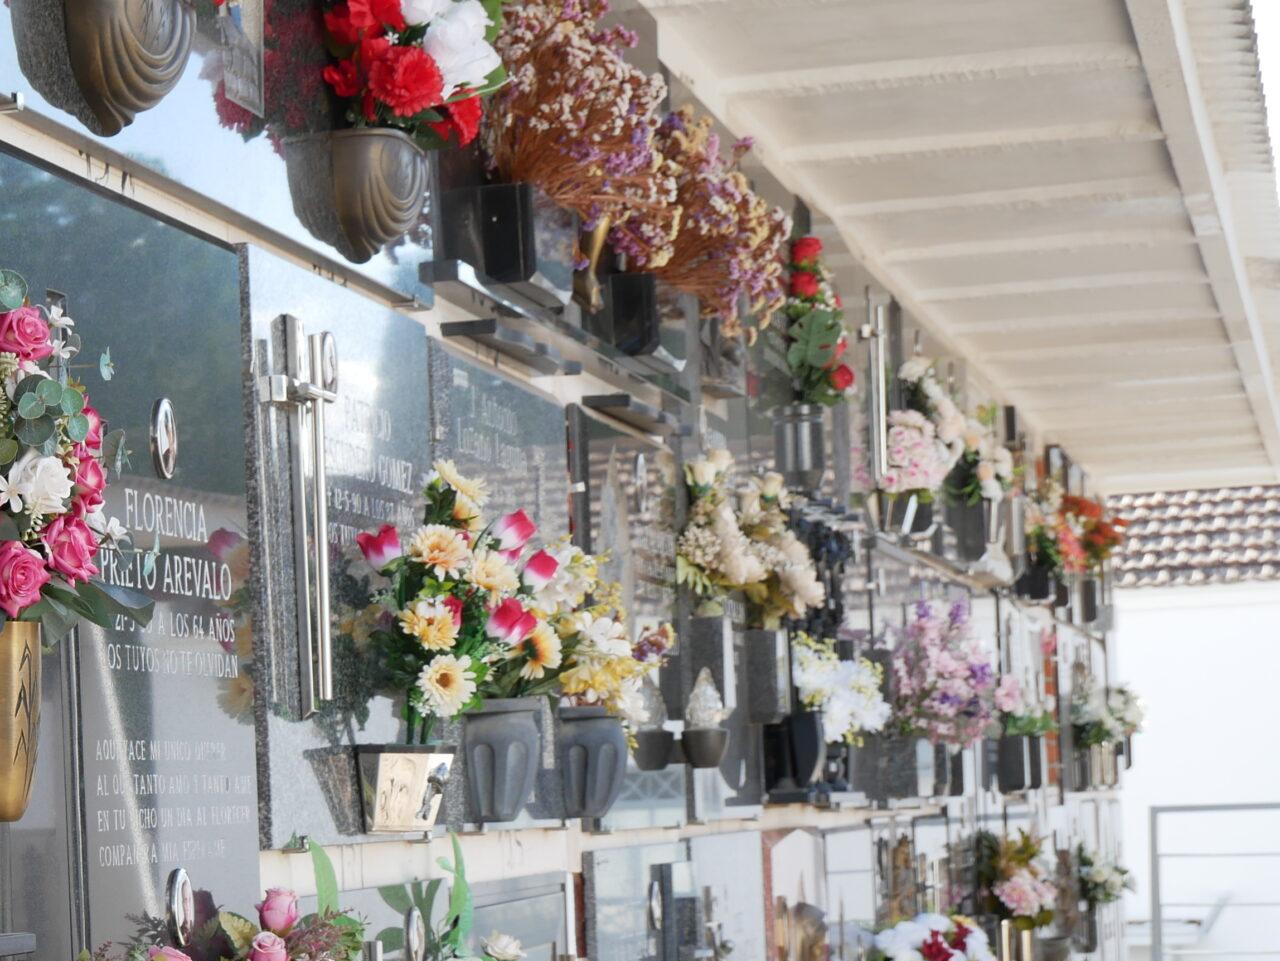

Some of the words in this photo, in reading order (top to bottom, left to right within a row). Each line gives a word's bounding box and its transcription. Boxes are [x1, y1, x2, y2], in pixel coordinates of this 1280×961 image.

[124, 487, 209, 544] FLORENCIA
[162, 553, 232, 601] AREVALO
[169, 611, 189, 638] LOS
[209, 612, 236, 643] AÑOS
[107, 643, 122, 670] OS
[125, 644, 160, 673] TUYOS
[195, 651, 239, 679] OLVIDAN
